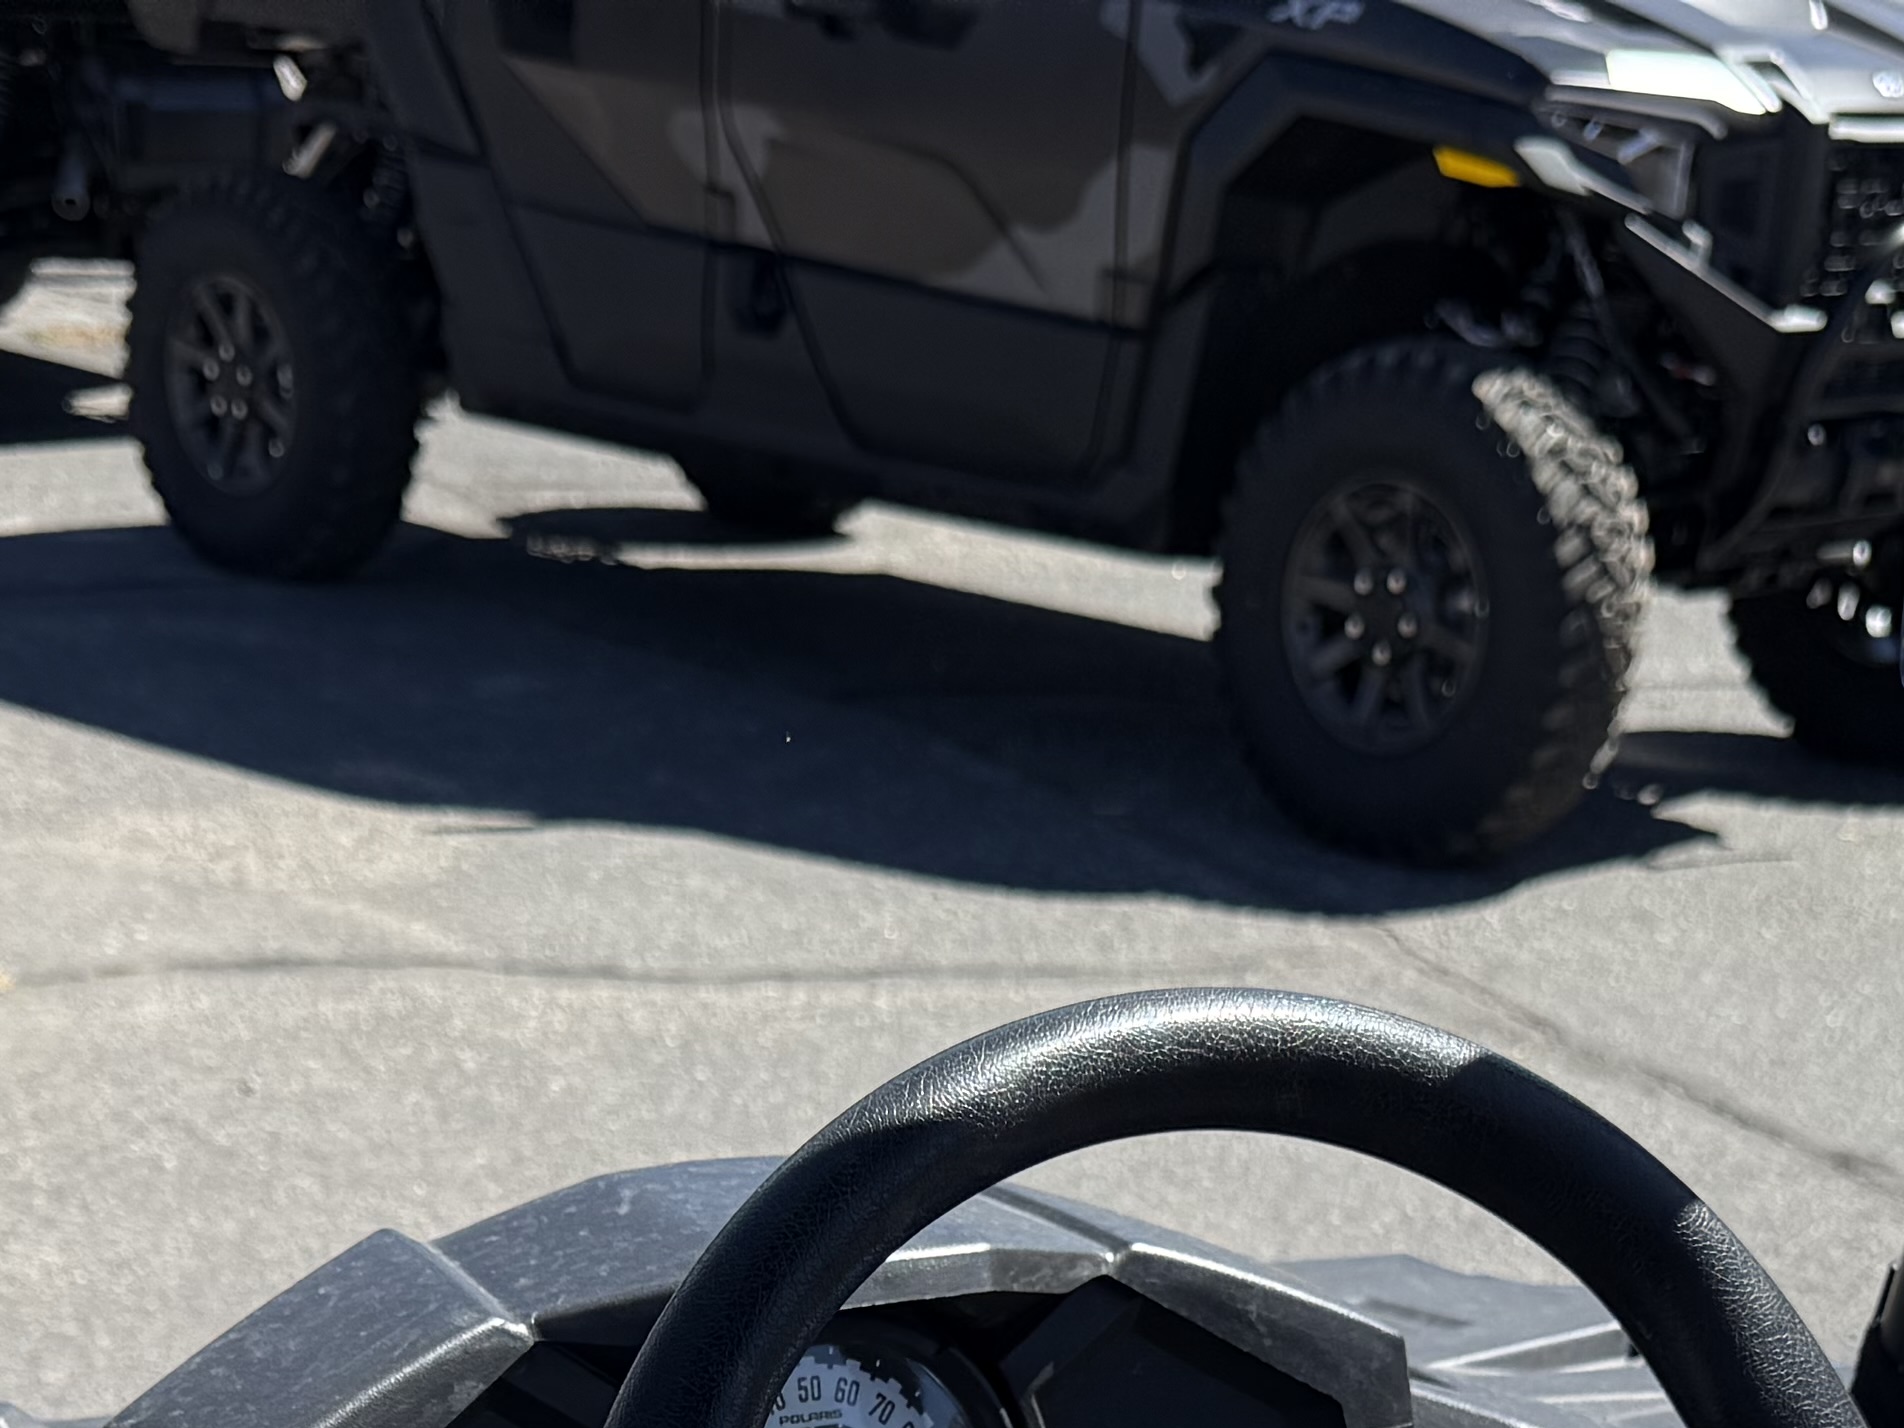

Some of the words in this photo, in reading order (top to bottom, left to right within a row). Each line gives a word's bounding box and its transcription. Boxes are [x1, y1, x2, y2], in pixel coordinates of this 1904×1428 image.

[797, 1375, 821, 1403] 50
[834, 1377, 860, 1406] 60
[779, 1409, 842, 1425] POLARIS
[868, 1392, 895, 1425] 70
